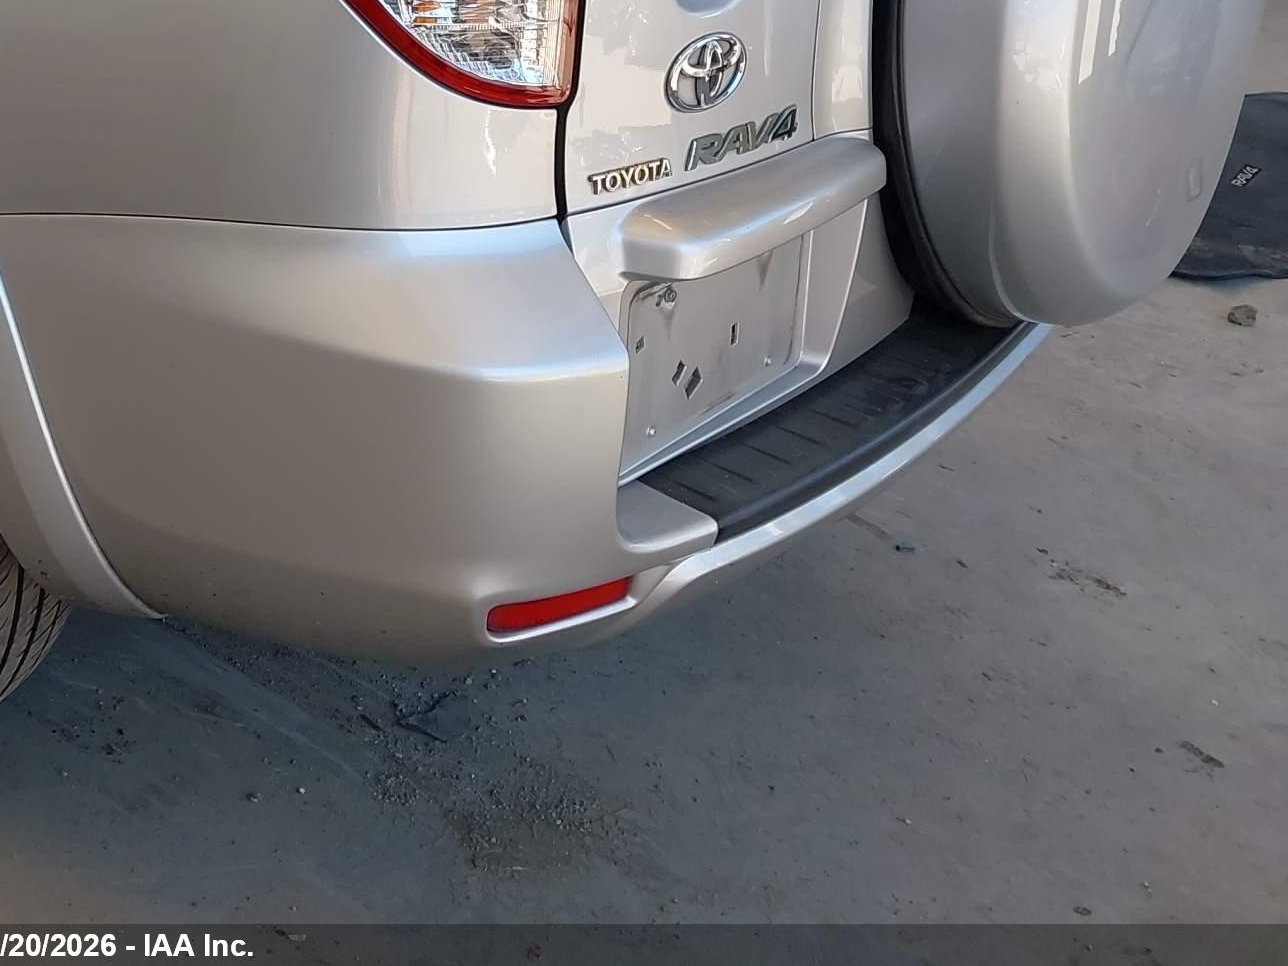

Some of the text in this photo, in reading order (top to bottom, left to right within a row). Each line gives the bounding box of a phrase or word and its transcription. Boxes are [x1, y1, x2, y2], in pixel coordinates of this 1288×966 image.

[590, 104, 799, 195] TOYOTA RAV4
[1231, 166, 1259, 187] RAV4
